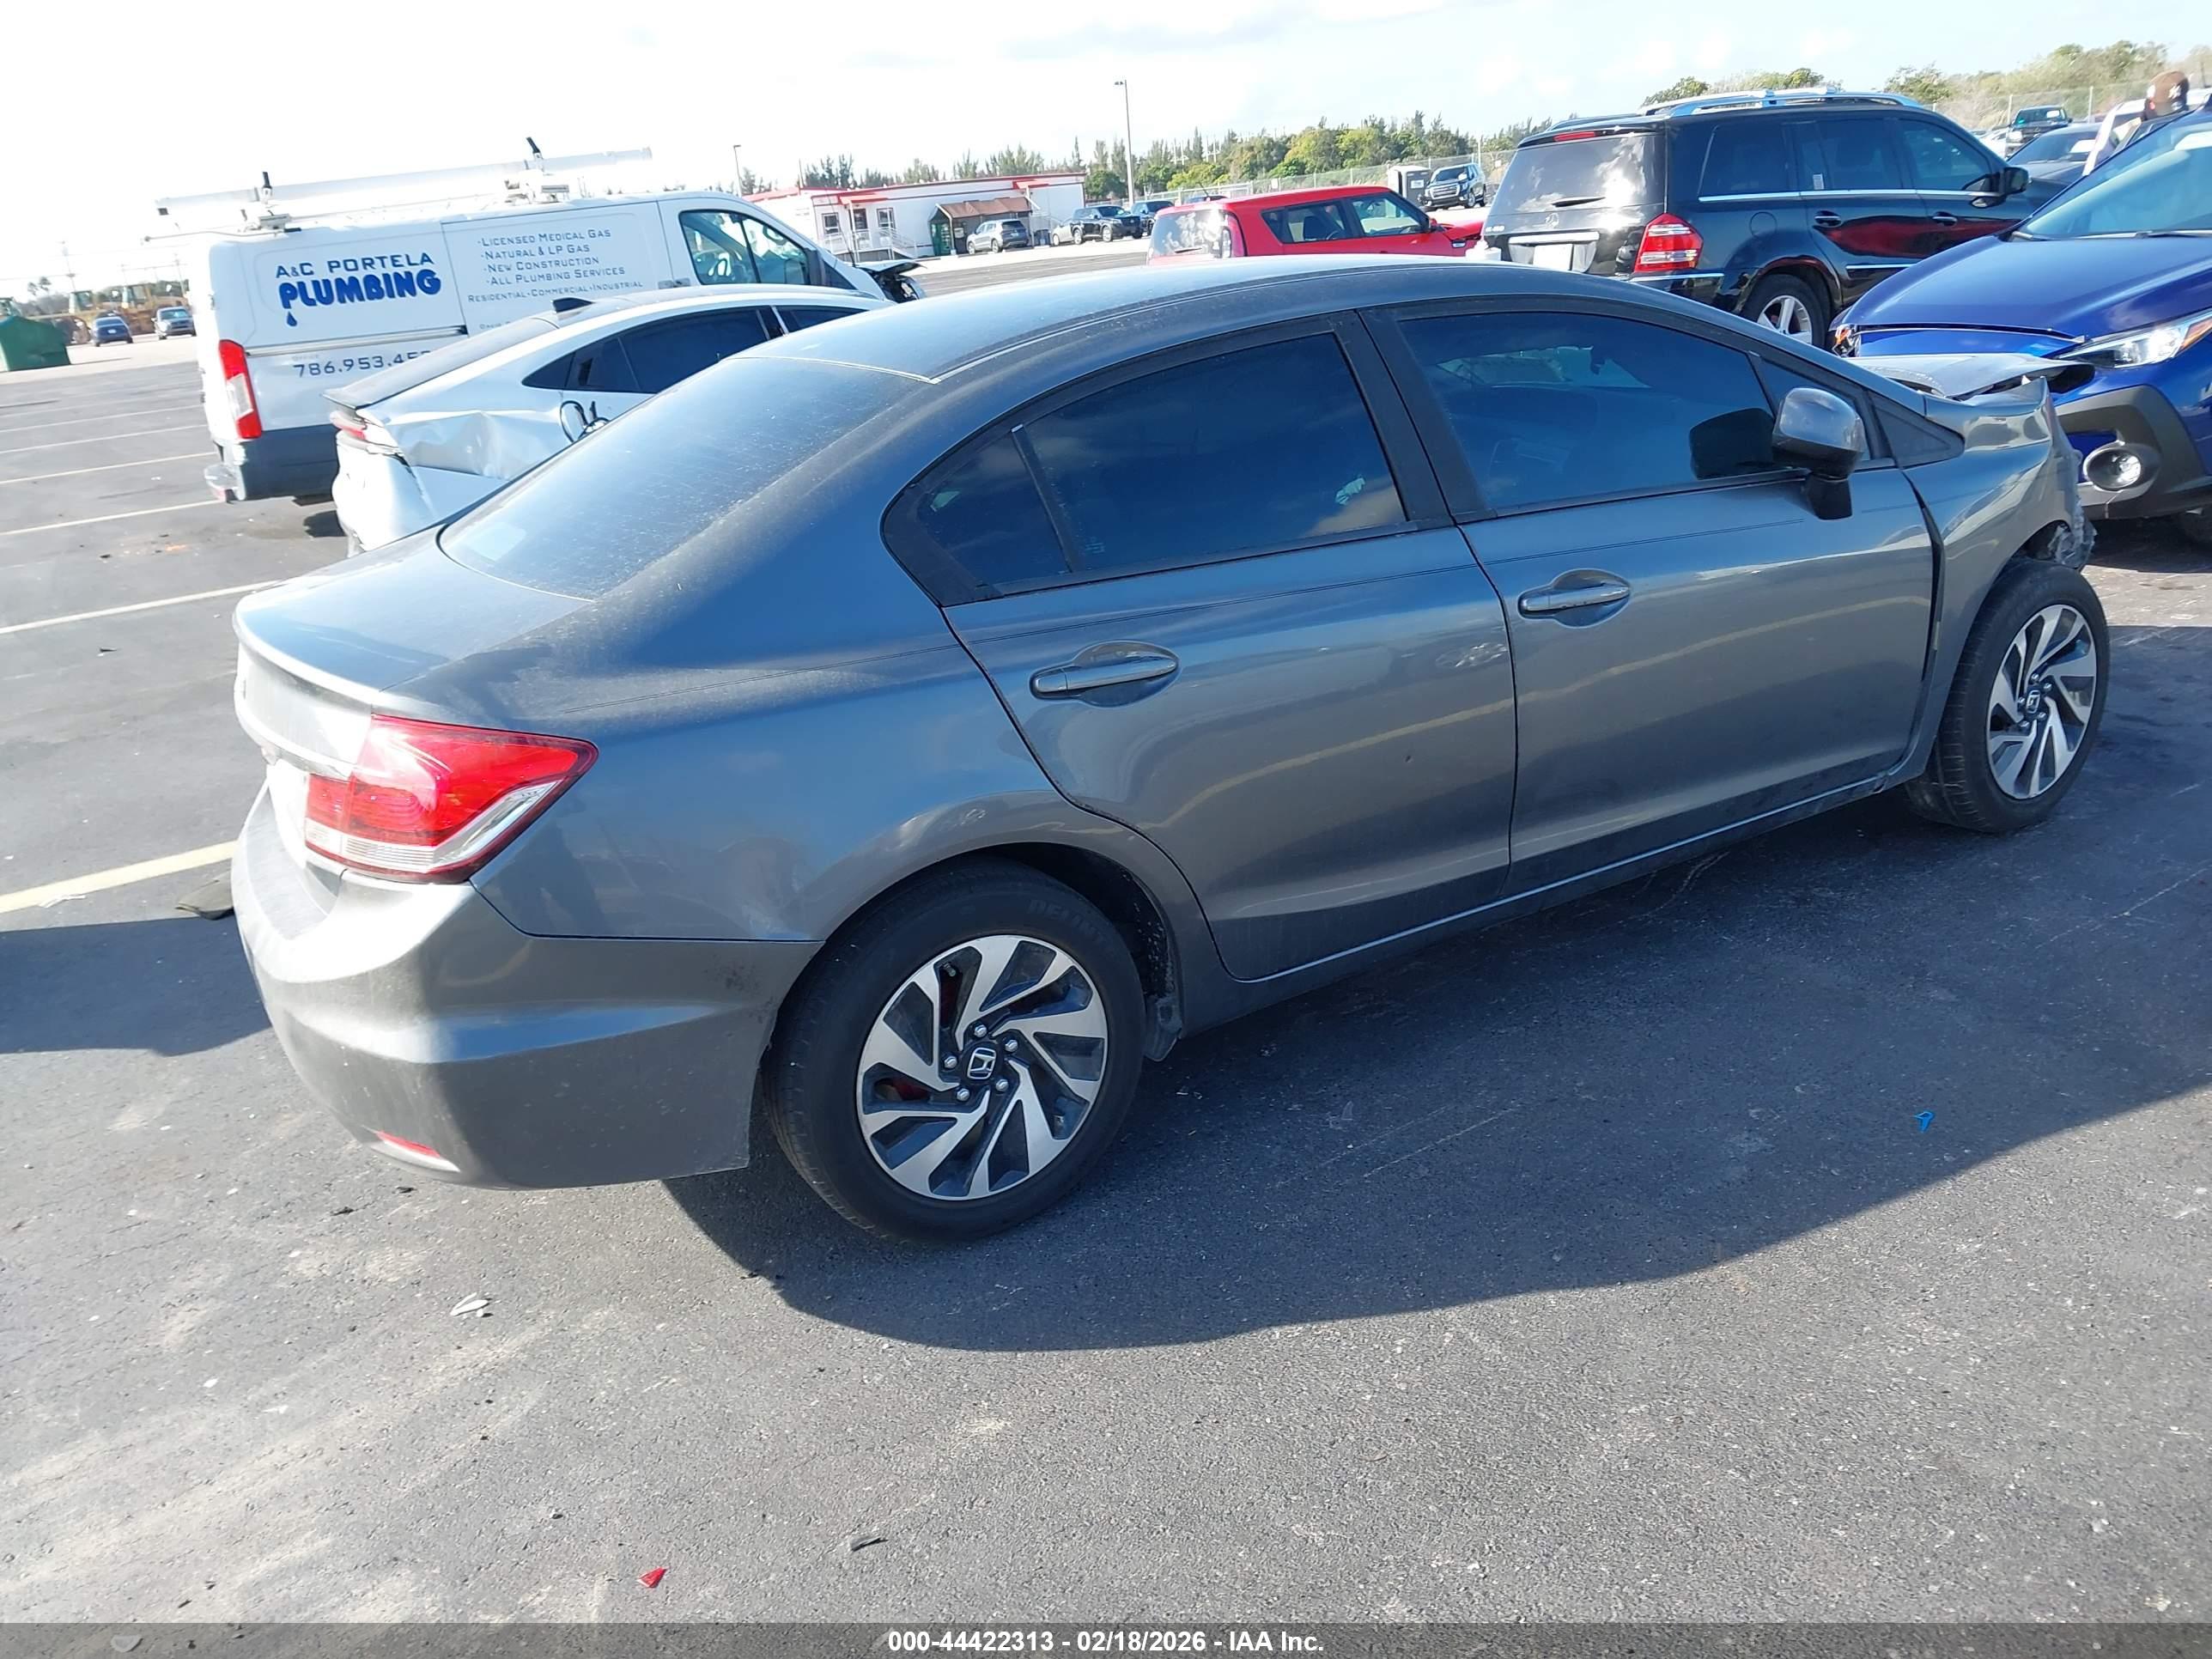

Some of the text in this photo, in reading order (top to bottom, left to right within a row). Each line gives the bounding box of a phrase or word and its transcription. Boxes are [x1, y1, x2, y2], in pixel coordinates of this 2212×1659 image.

[587, 228, 611, 239] GAS
[538, 246, 544, 256] &
[549, 245, 562, 255] LP
[567, 244, 590, 253] GAS
[276, 252, 434, 278] A&C PORTELA
[516, 257, 599, 270] CONSTRUCTION
[278, 269, 441, 310] PLUMBING
[293, 350, 431, 378] 786.953.45
